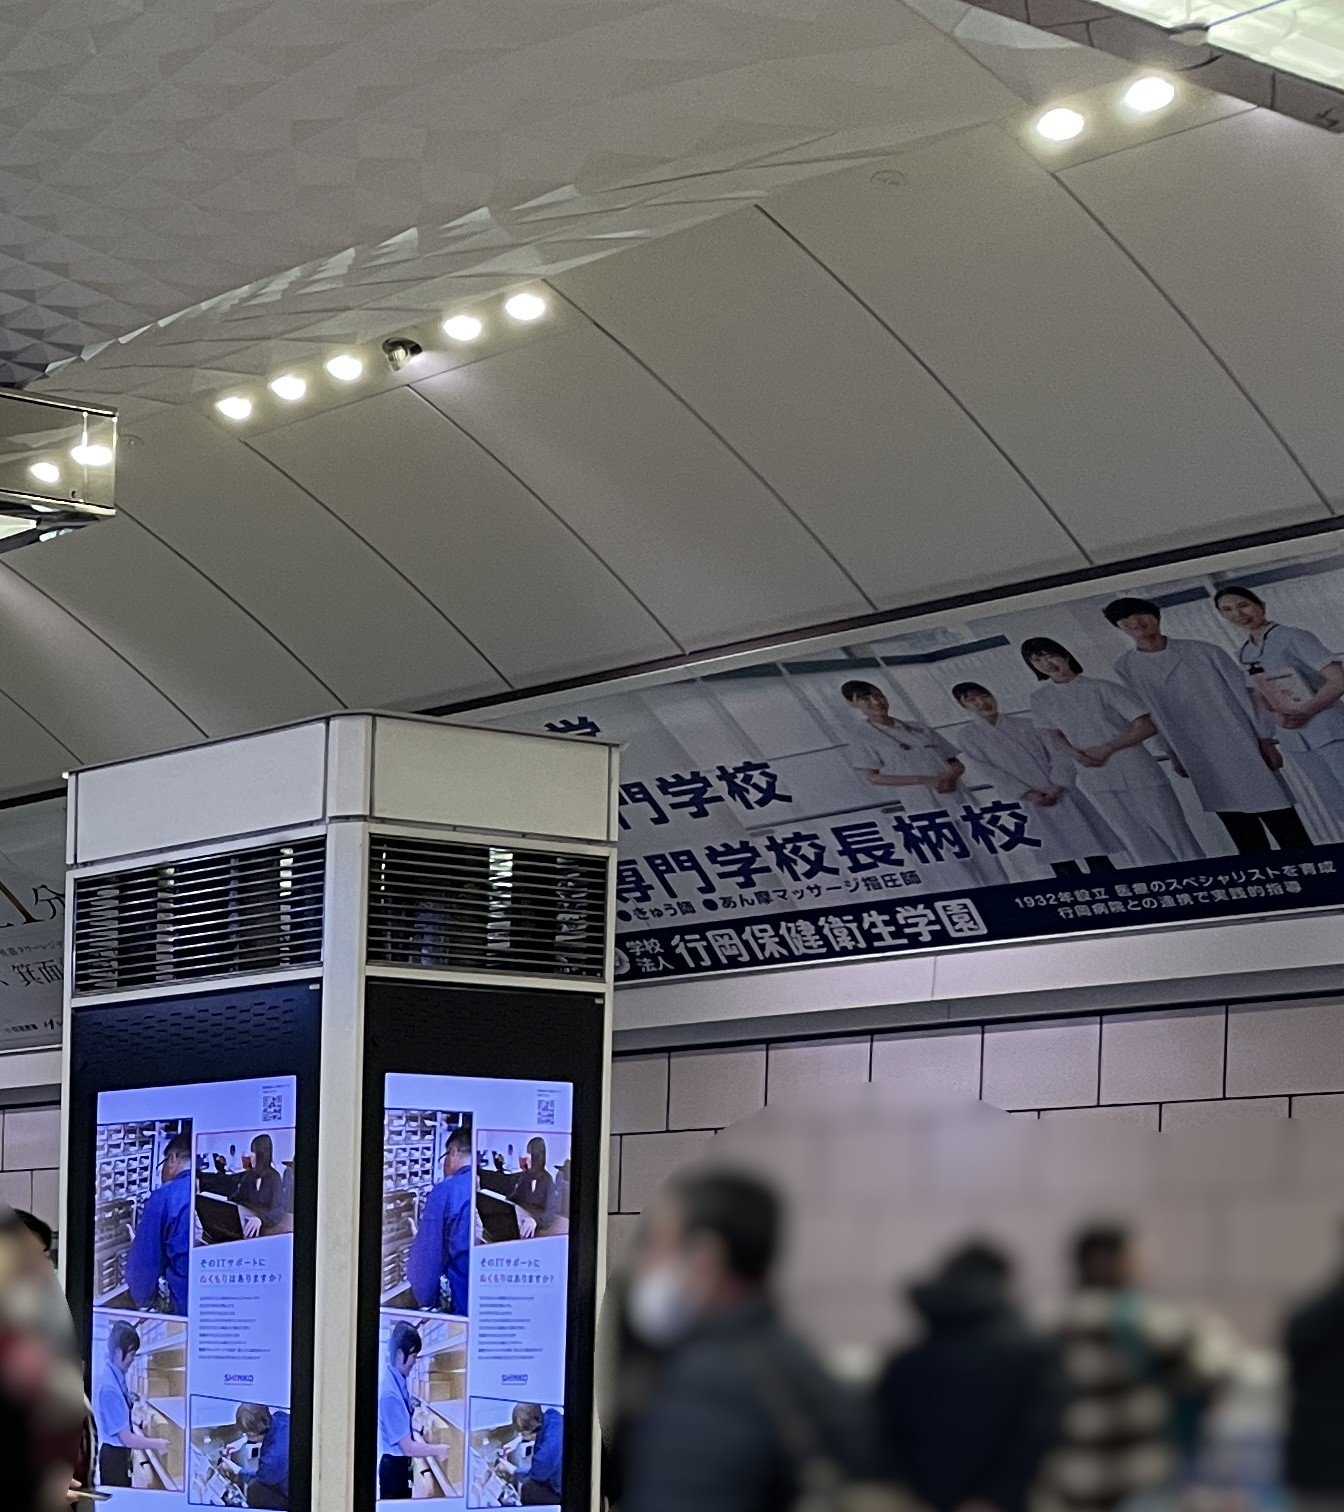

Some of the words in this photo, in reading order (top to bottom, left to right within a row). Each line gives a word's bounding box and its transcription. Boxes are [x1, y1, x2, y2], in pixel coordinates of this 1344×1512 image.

[616, 800, 1042, 904] 専門学校長柄校
[625, 938, 666, 957] 学校
[670, 897, 990, 969] 行岡保健衛生学園
[12, 957, 63, 987] 箕面
